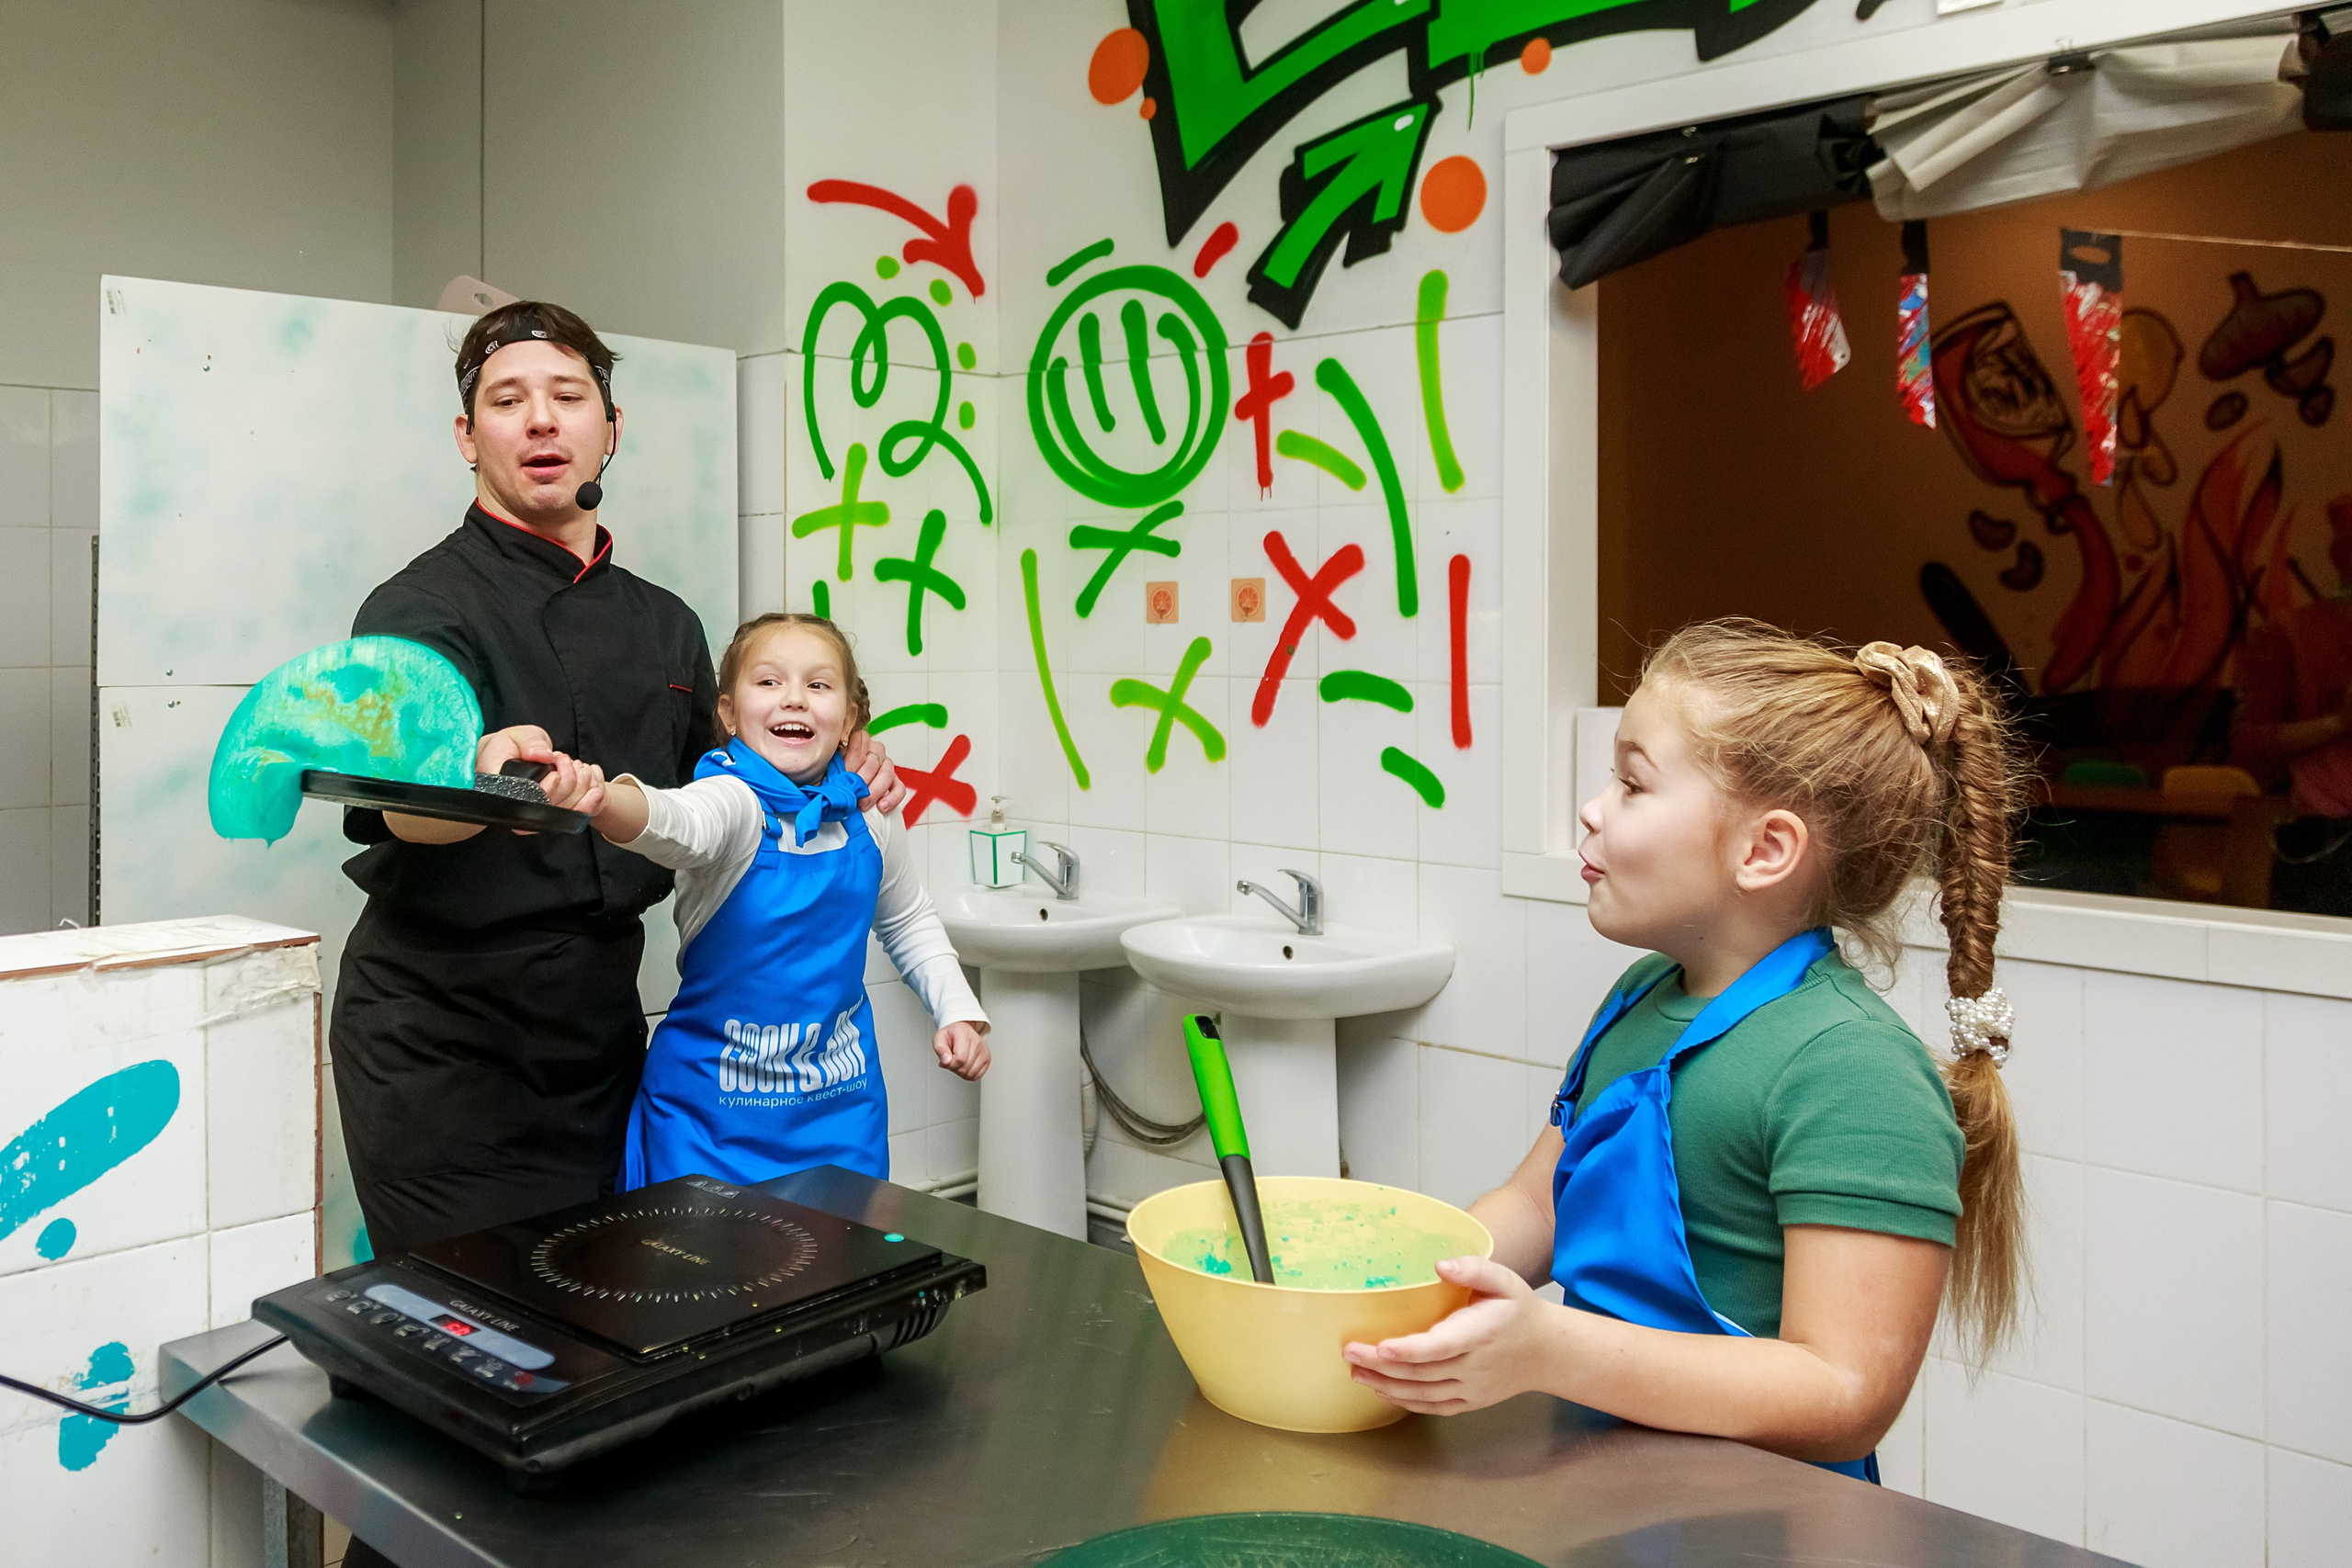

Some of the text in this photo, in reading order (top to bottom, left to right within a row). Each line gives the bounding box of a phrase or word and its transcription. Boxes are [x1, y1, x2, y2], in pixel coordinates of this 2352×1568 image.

[719, 1078, 867, 1109] кулинарное квест-шоу
[679, 1254, 711, 1266] LINE
[449, 1300, 493, 1320] GALAXY
[490, 1318, 520, 1332] LINE
